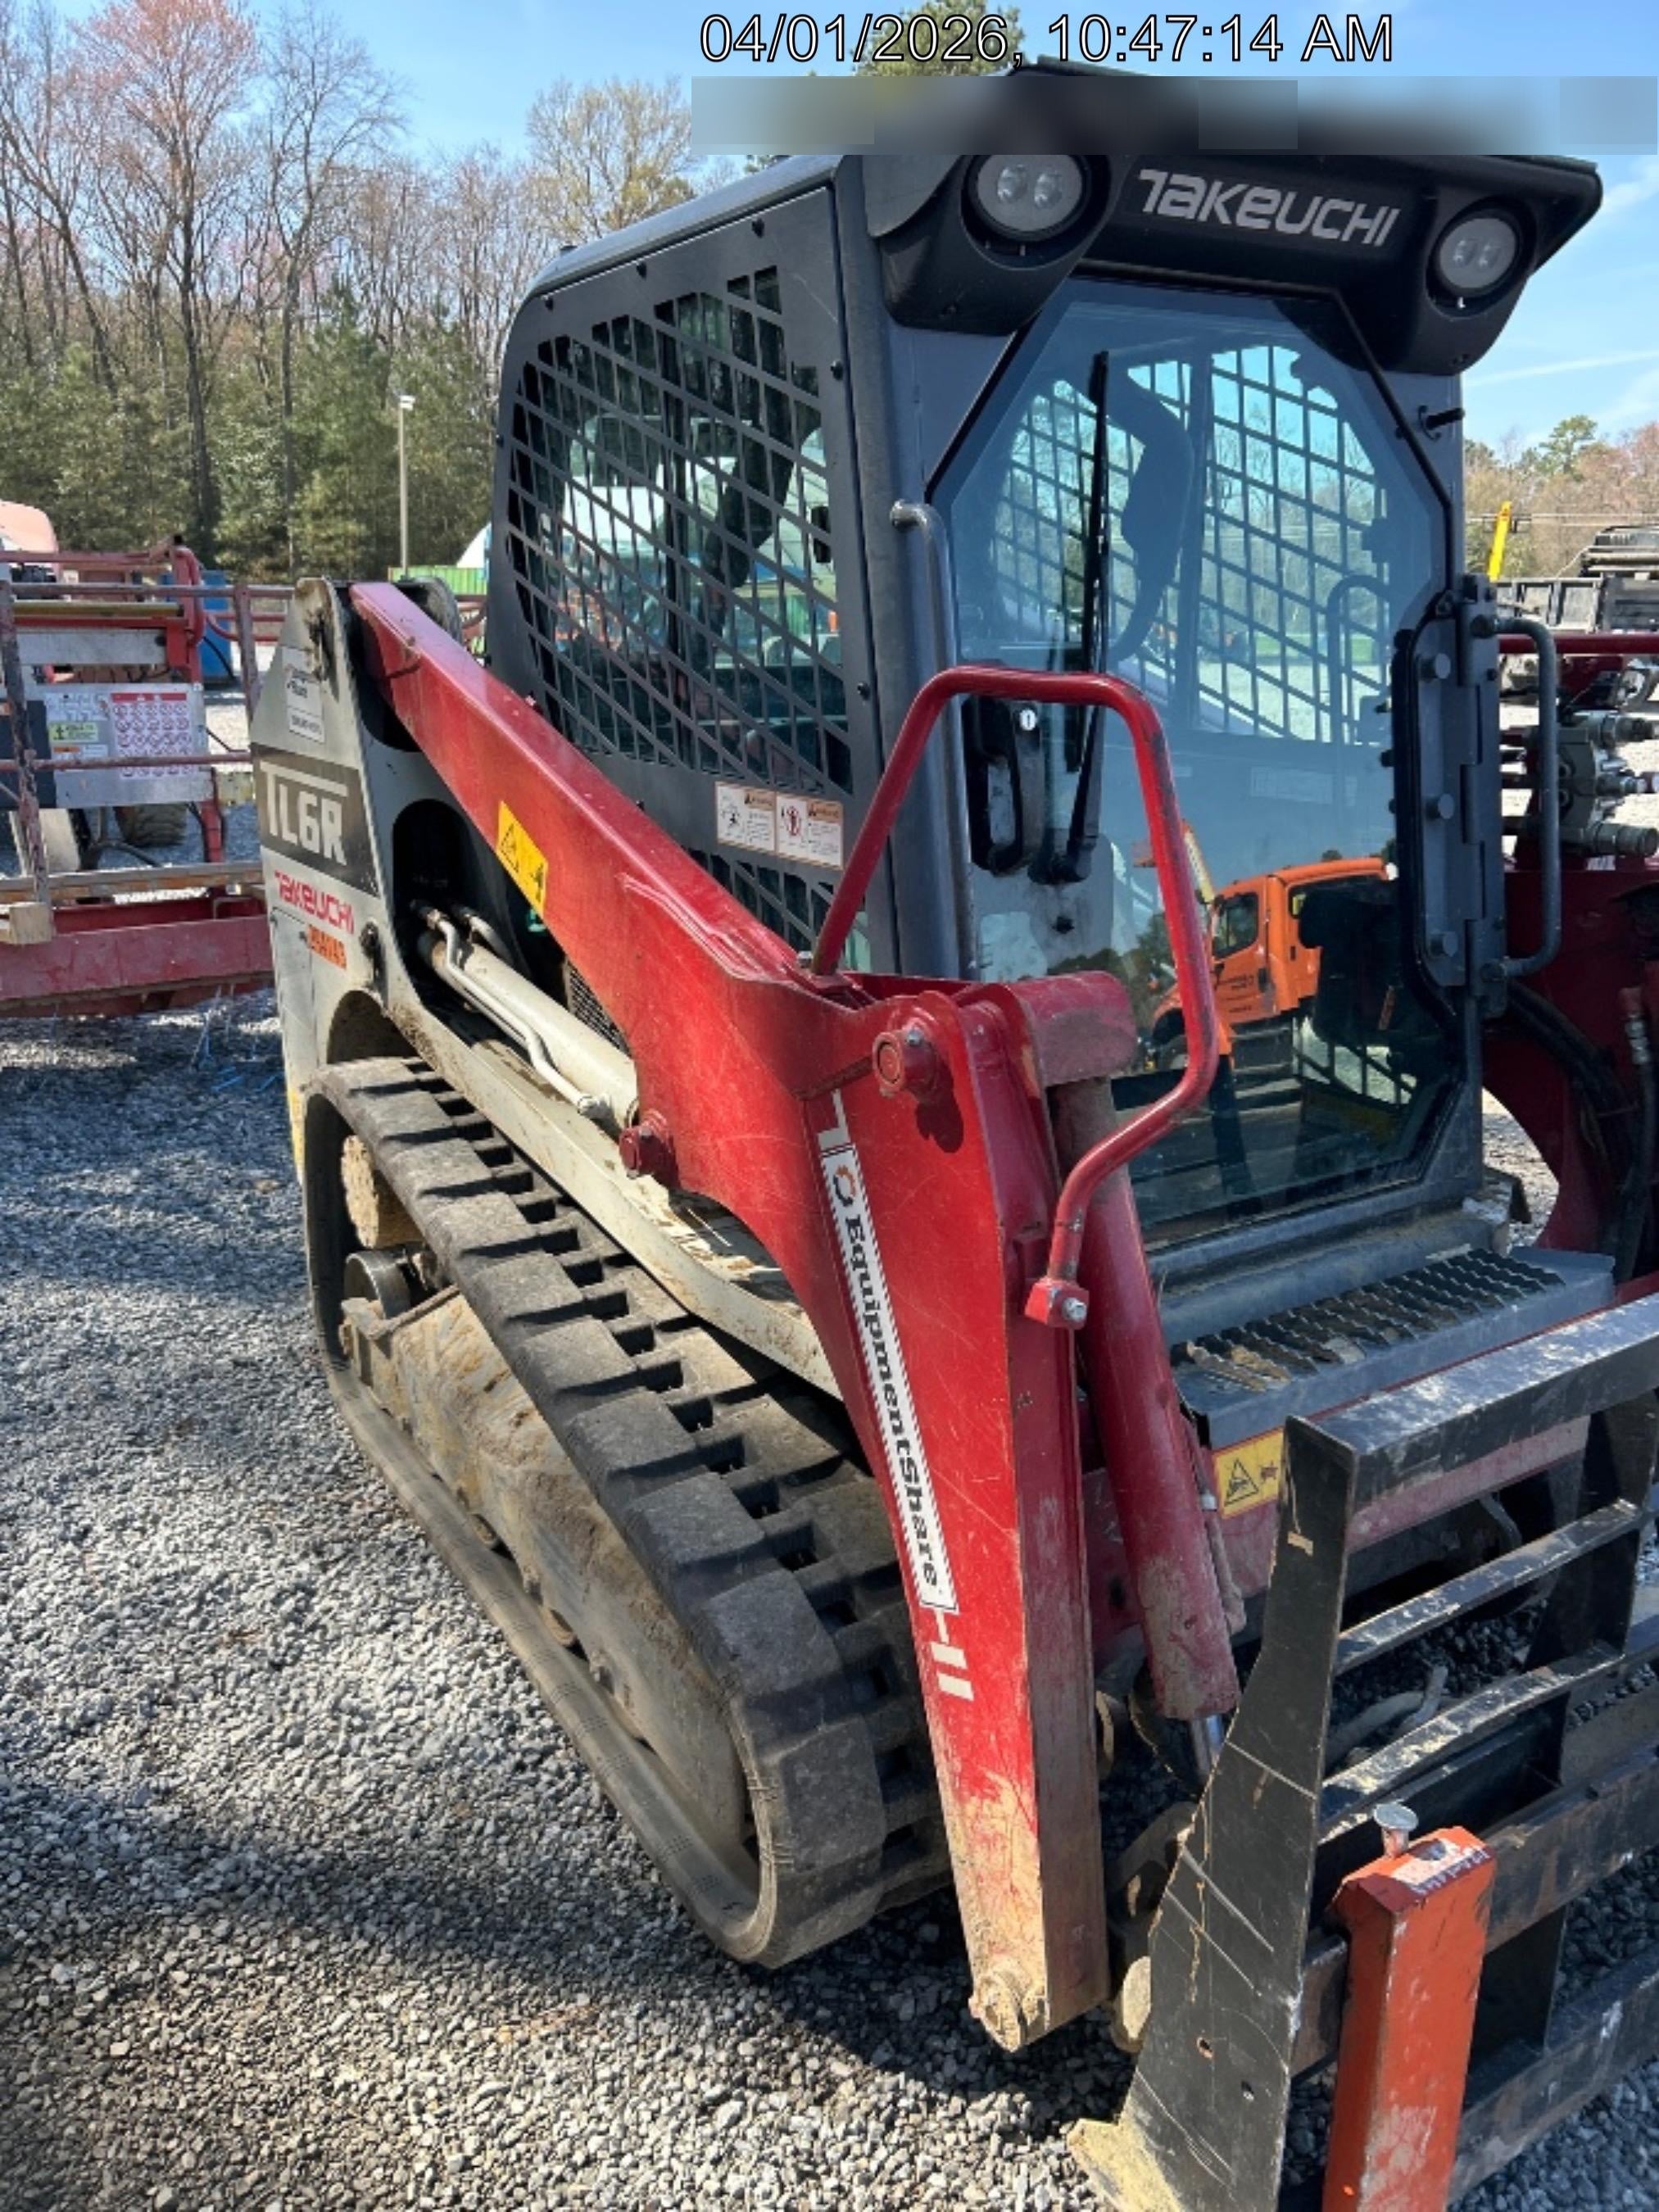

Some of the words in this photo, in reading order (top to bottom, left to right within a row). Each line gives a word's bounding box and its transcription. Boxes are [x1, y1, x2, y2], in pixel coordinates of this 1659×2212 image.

[1139, 169, 1401, 247] TAKEUCHI
[260, 760, 348, 866] TL6R
[274, 869, 355, 936] TAKEUCHI
[844, 1213, 939, 1589] EquipmentShare
